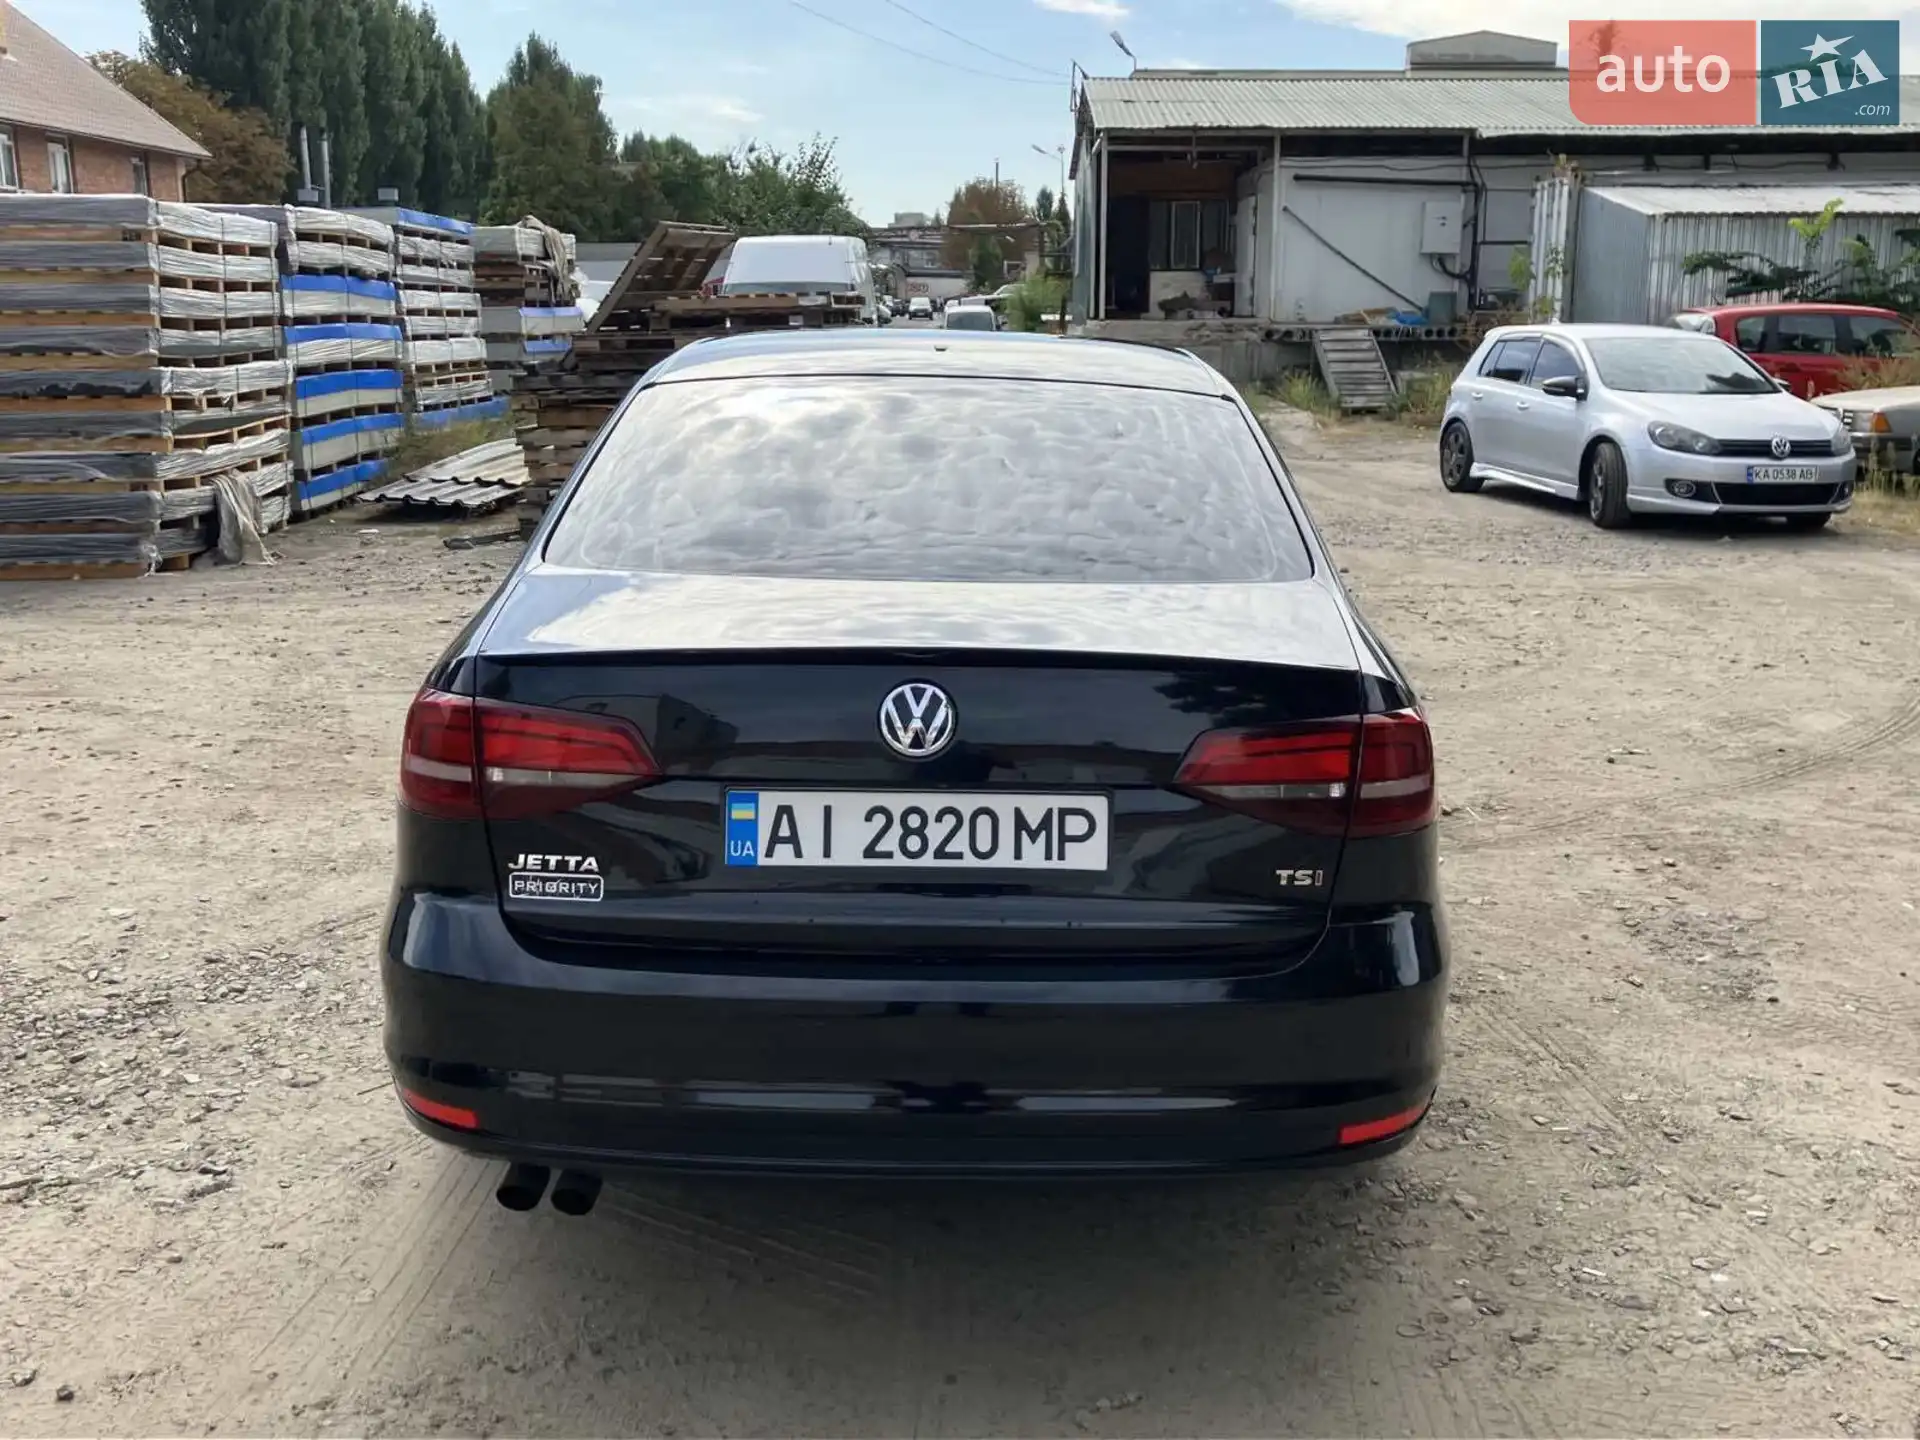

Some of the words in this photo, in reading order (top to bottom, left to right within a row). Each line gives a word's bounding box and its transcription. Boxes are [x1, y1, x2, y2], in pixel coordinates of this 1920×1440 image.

[1755, 467, 1770, 481] KA
[880, 682, 953, 757] VW
[764, 804, 832, 859] AI
[862, 804, 999, 861] 2820
[1013, 806, 1097, 861] MP
[730, 840, 755, 857] UA
[508, 853, 599, 872] JETTA
[514, 879, 599, 895] PRIORITY
